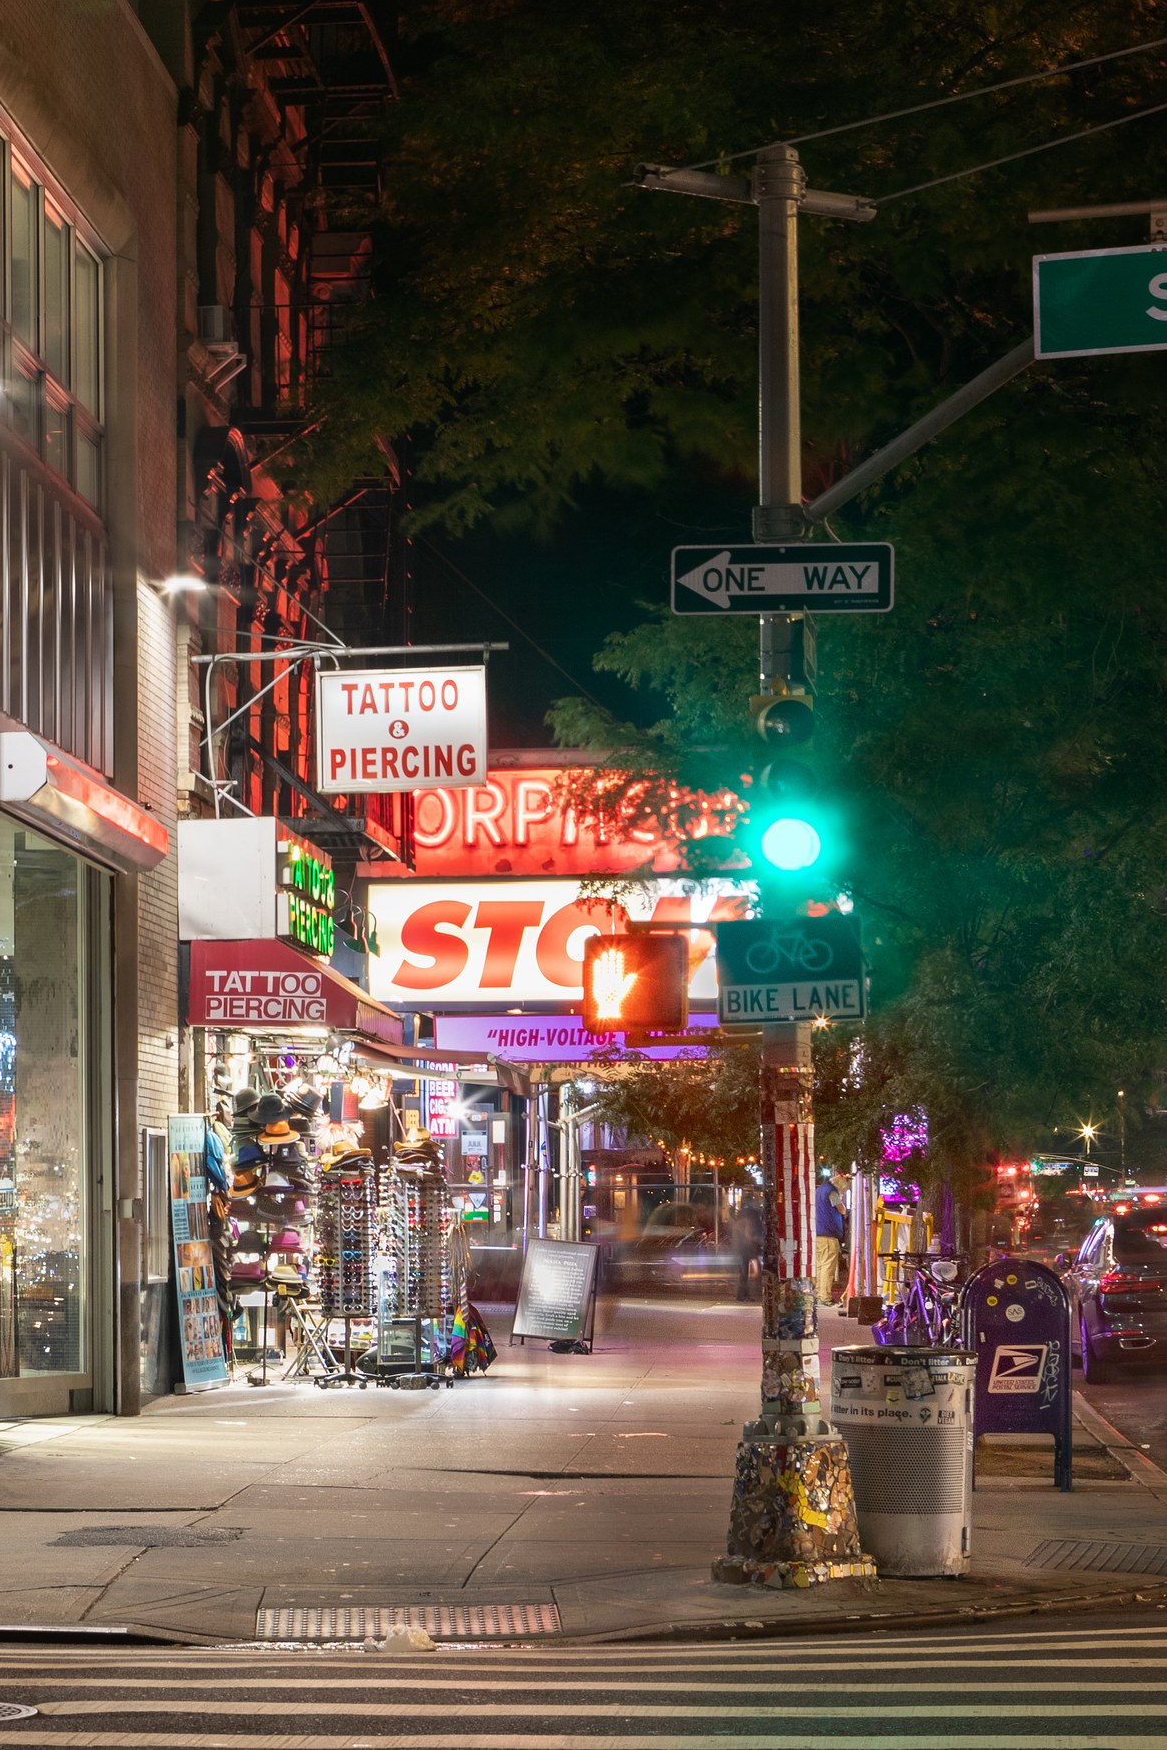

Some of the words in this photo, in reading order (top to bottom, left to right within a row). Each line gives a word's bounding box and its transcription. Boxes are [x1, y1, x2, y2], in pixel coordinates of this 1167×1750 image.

[703, 567, 765, 592] ONE
[803, 565, 871, 591] WAY
[341, 679, 458, 715] TATTOO
[390, 720, 408, 739] &
[330, 744, 476, 781] PIERCING
[289, 892, 335, 958] PIERCING
[205, 970, 321, 995] TATTOO
[206, 997, 325, 1021] PIERCING
[728, 988, 779, 1013] BIKE
[793, 985, 855, 1011] LANE
[429, 1080, 456, 1097] BEER
[430, 1118, 456, 1135] ATM
[1007, 1306, 1023, 1316] SAS
[839, 1354, 854, 1363] Don't
[855, 1355, 875, 1364] litter
[901, 1357, 926, 1366] Don't
[928, 1358, 949, 1366] litter
[850, 1405, 858, 1415] in
[861, 1406, 874, 1416] its
[878, 1408, 913, 1418] place.
